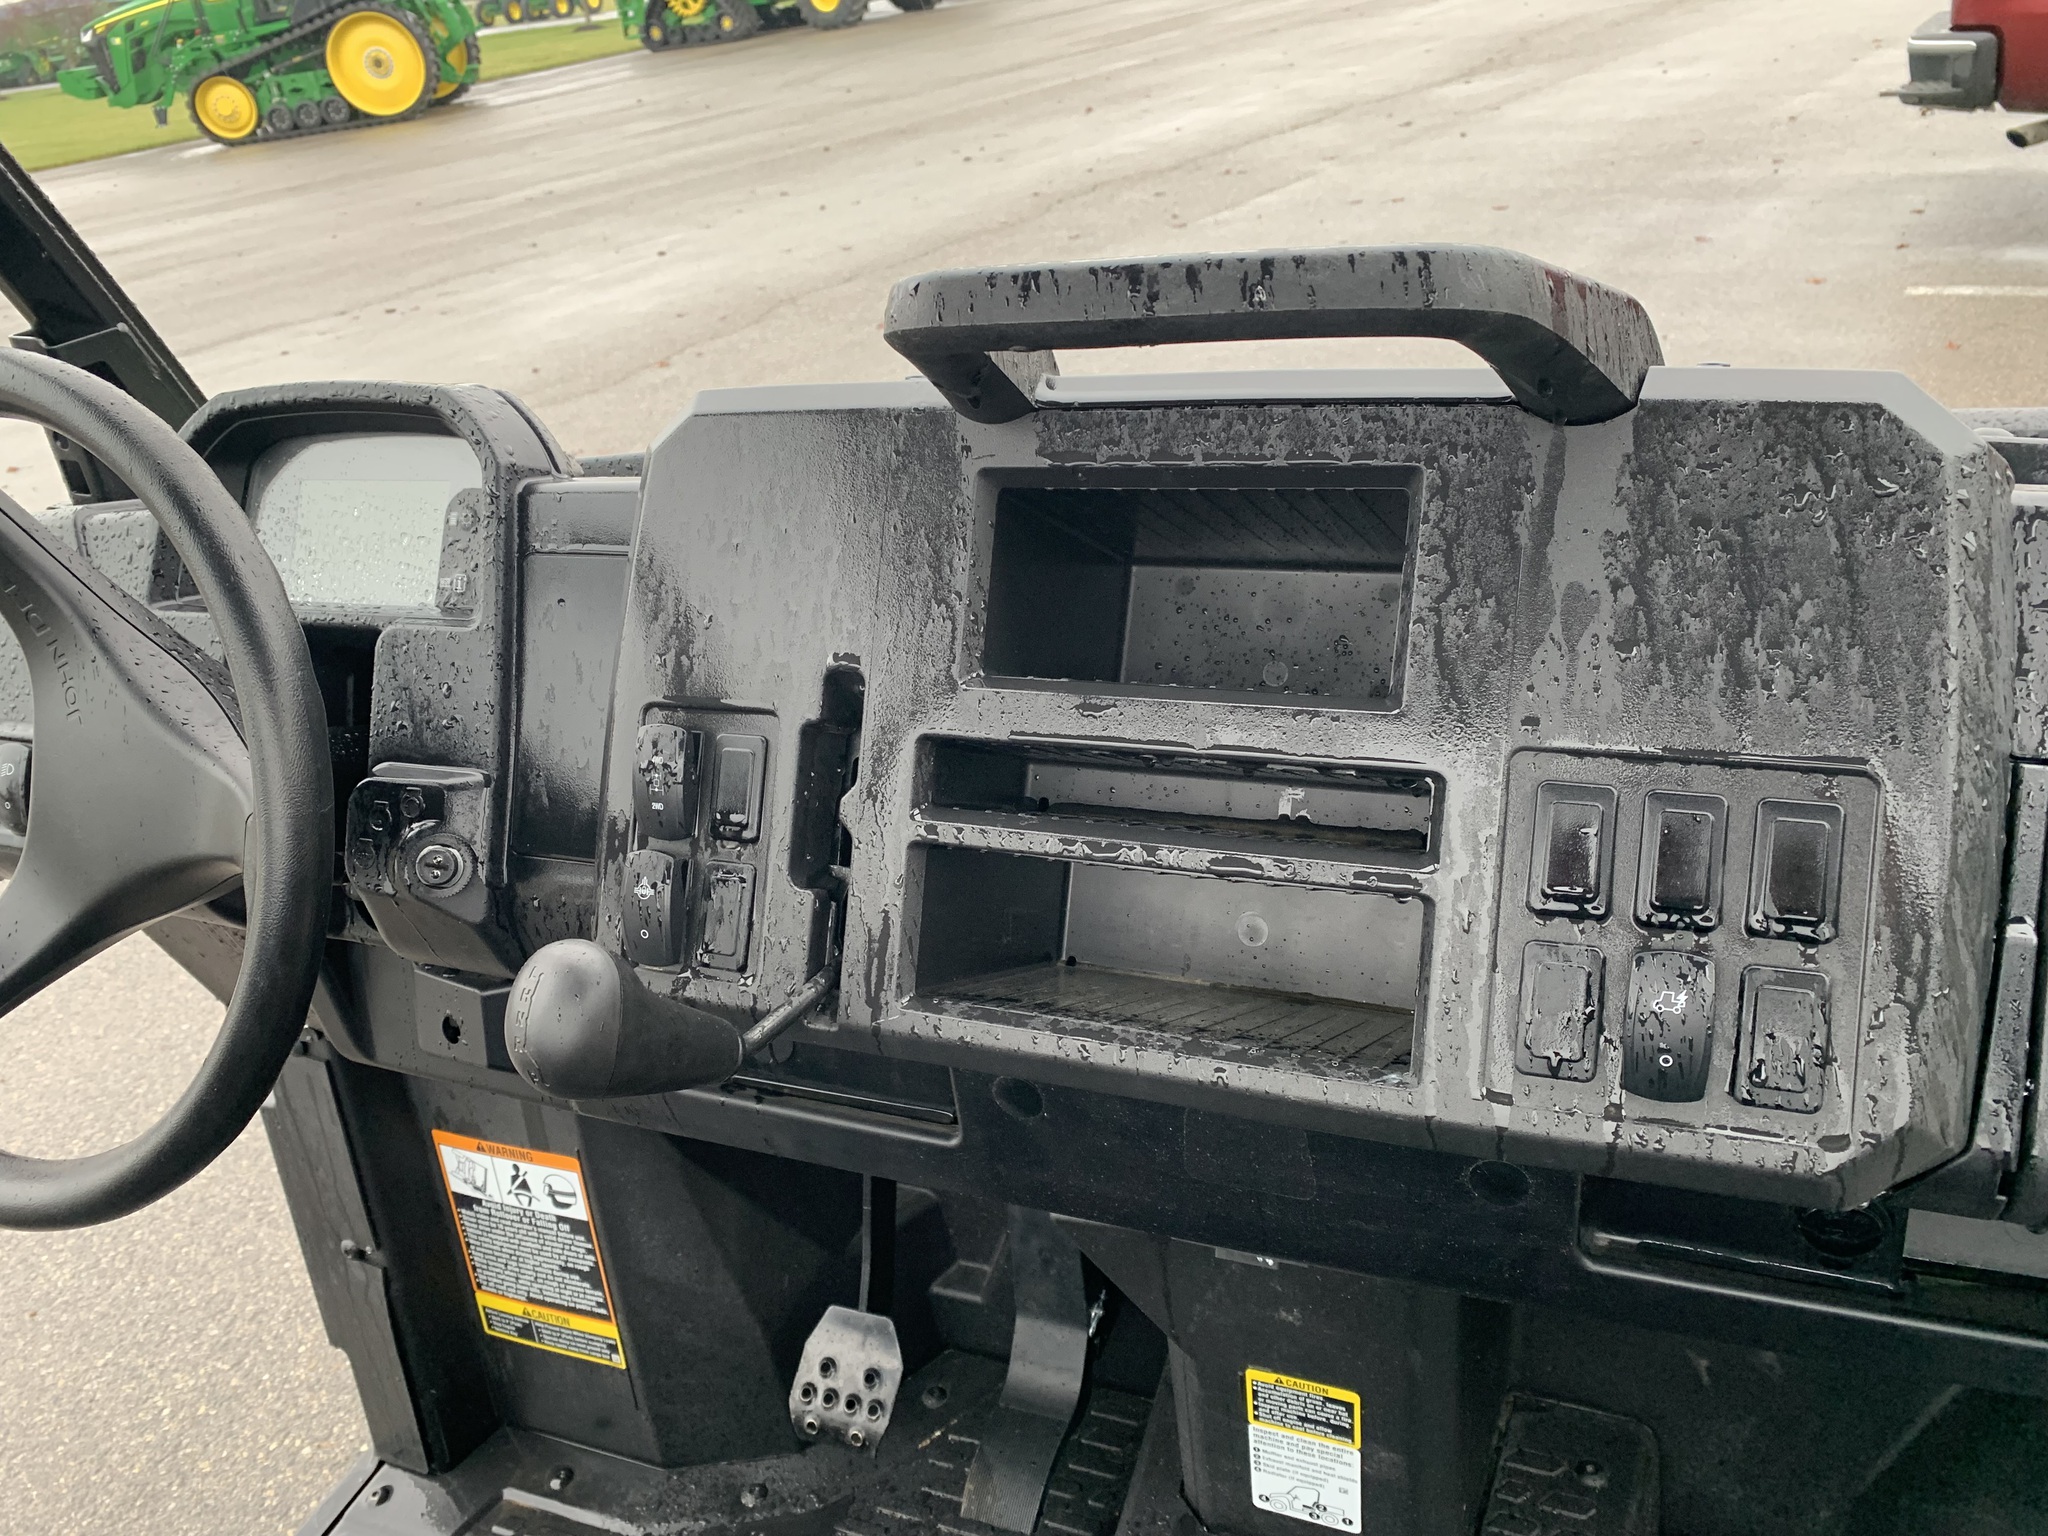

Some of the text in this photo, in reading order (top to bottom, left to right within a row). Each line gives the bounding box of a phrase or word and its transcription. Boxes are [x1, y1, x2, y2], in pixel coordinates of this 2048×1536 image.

[651, 801, 665, 812] 2WD
[486, 1143, 533, 1162] WARNING
[472, 1204, 571, 1233] from Rollover or Falling Off
[502, 1204, 524, 1217] Injury
[534, 1212, 557, 1222] Death
[531, 1309, 571, 1326] CAUTION
[1286, 1379, 1328, 1395] CAUTION
[1253, 1426, 1278, 1438] Inspect
[1281, 1433, 1294, 1441] and
[1299, 1438, 1316, 1446] clean
[1332, 1446, 1354, 1456] entire
[1253, 1432, 1283, 1444] machine
[1302, 1445, 1314, 1453] pay
[1317, 1448, 1343, 1460] special
[1253, 1438, 1285, 1451] attention
[1296, 1449, 1316, 1458] these
